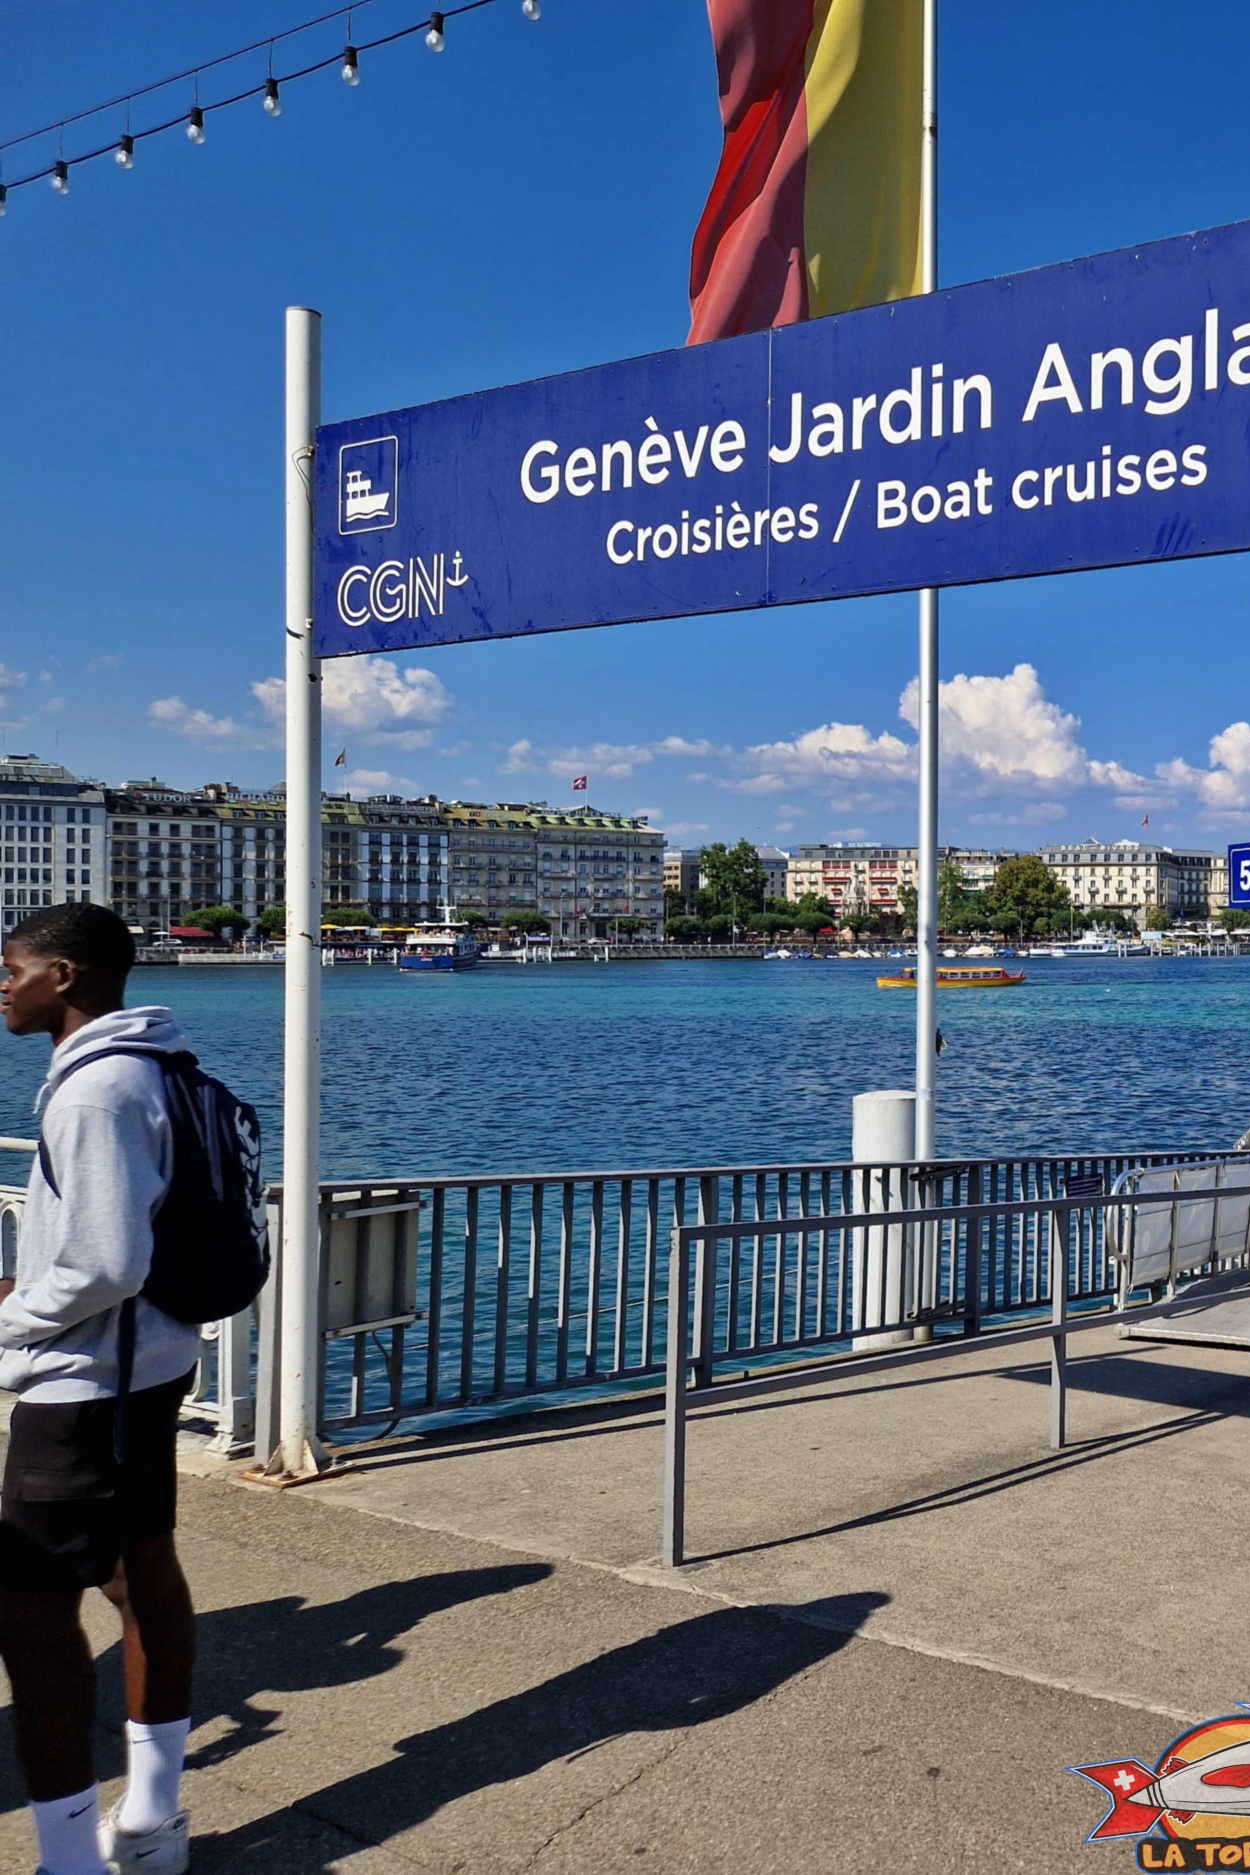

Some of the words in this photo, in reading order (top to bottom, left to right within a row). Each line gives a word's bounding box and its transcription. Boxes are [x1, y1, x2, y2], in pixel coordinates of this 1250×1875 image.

[520, 415, 746, 504] Genève
[768, 362, 992, 464] Jardin
[606, 500, 820, 565] Croisières
[831, 479, 862, 544] /
[876, 467, 994, 529] Boat
[1011, 443, 1208, 510] cruises
[336, 552, 445, 627] CGN
[145, 793, 193, 803] TUDOR
